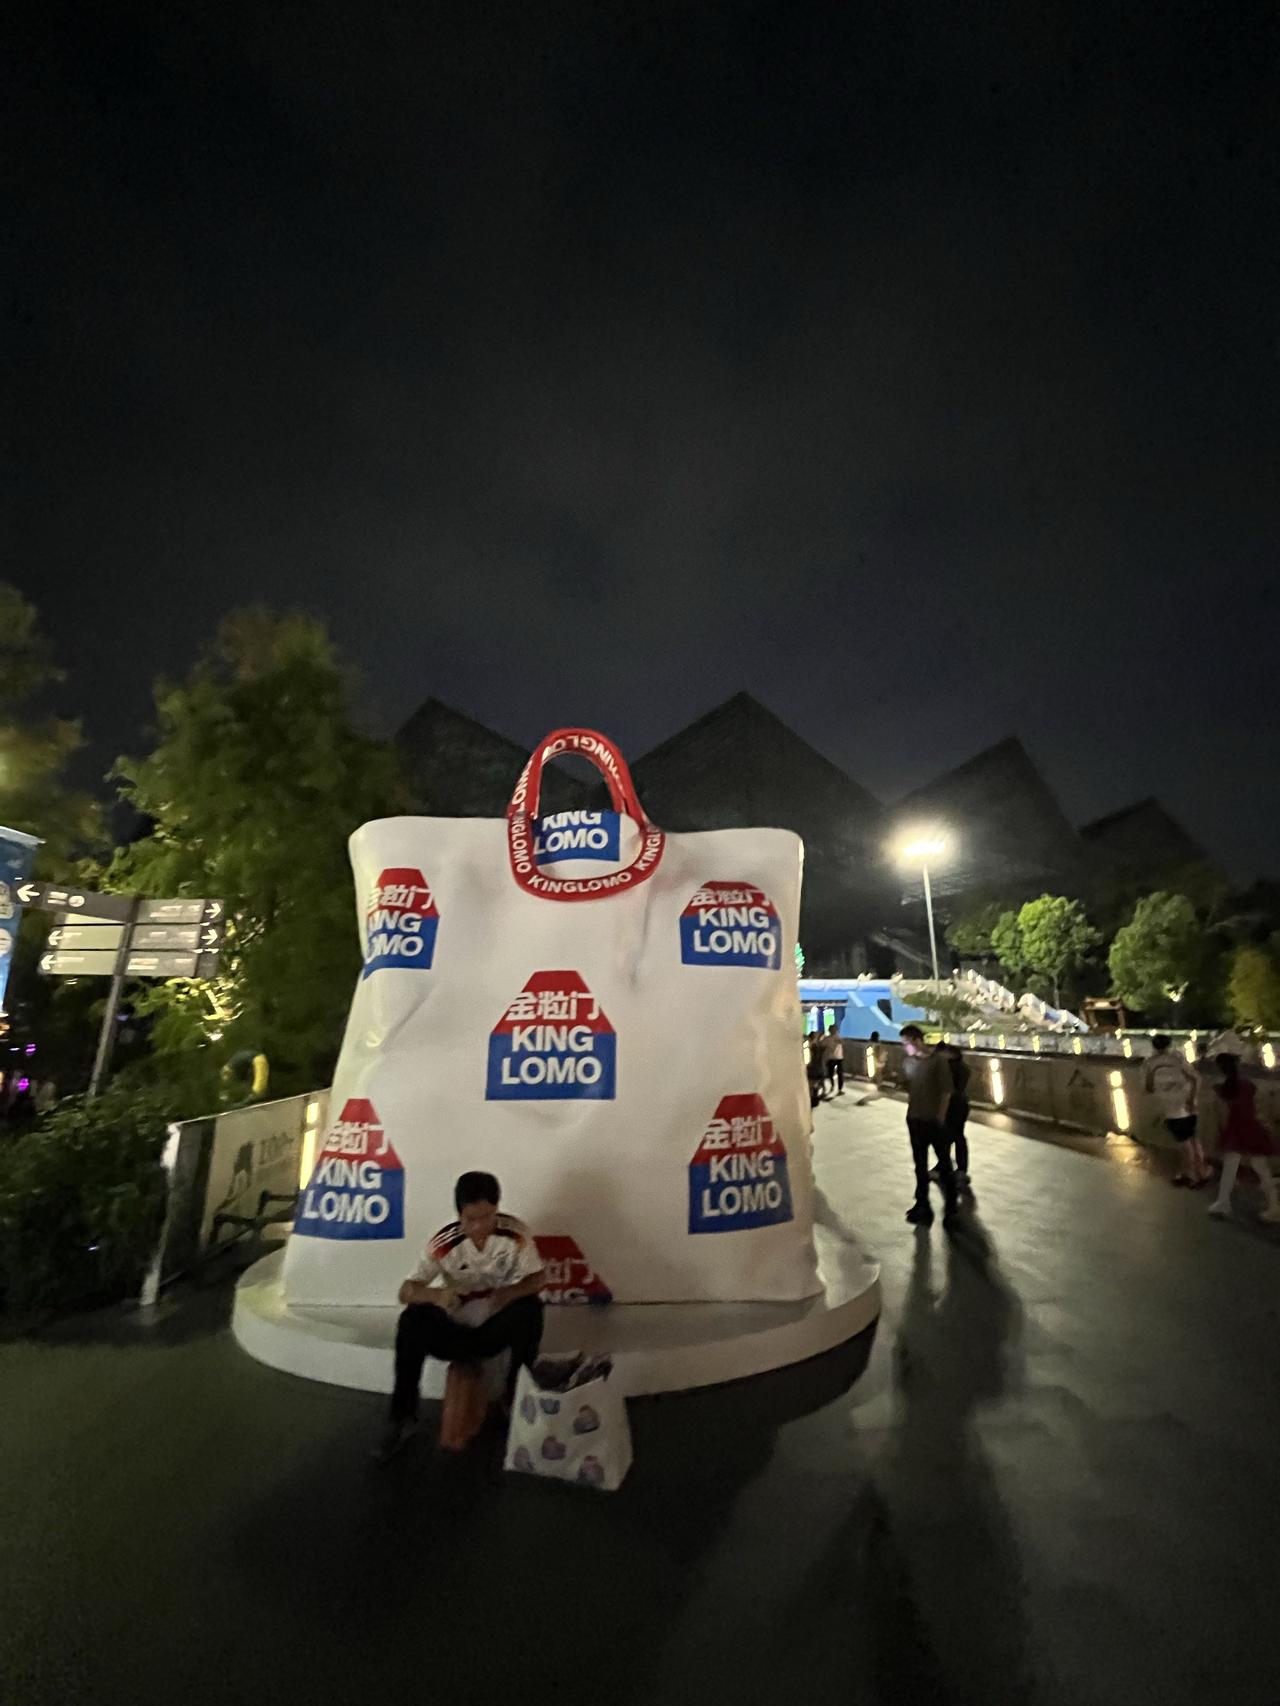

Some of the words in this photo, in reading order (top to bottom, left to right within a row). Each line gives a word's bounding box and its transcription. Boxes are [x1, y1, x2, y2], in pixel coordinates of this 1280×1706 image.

[534, 828, 608, 855] LOMO
[528, 872, 632, 893] KINGLOMO
[699, 906, 769, 928] KING
[694, 930, 776, 955] LOMO
[504, 991, 600, 1020] 金粒门
[512, 1025, 594, 1052] KING
[501, 1056, 602, 1085] LOMO
[702, 1115, 777, 1150] 金粒门
[316, 1157, 382, 1189] KING
[710, 1149, 775, 1182] KING
[302, 1190, 389, 1224] LOMO
[702, 1181, 782, 1217] LOMO
